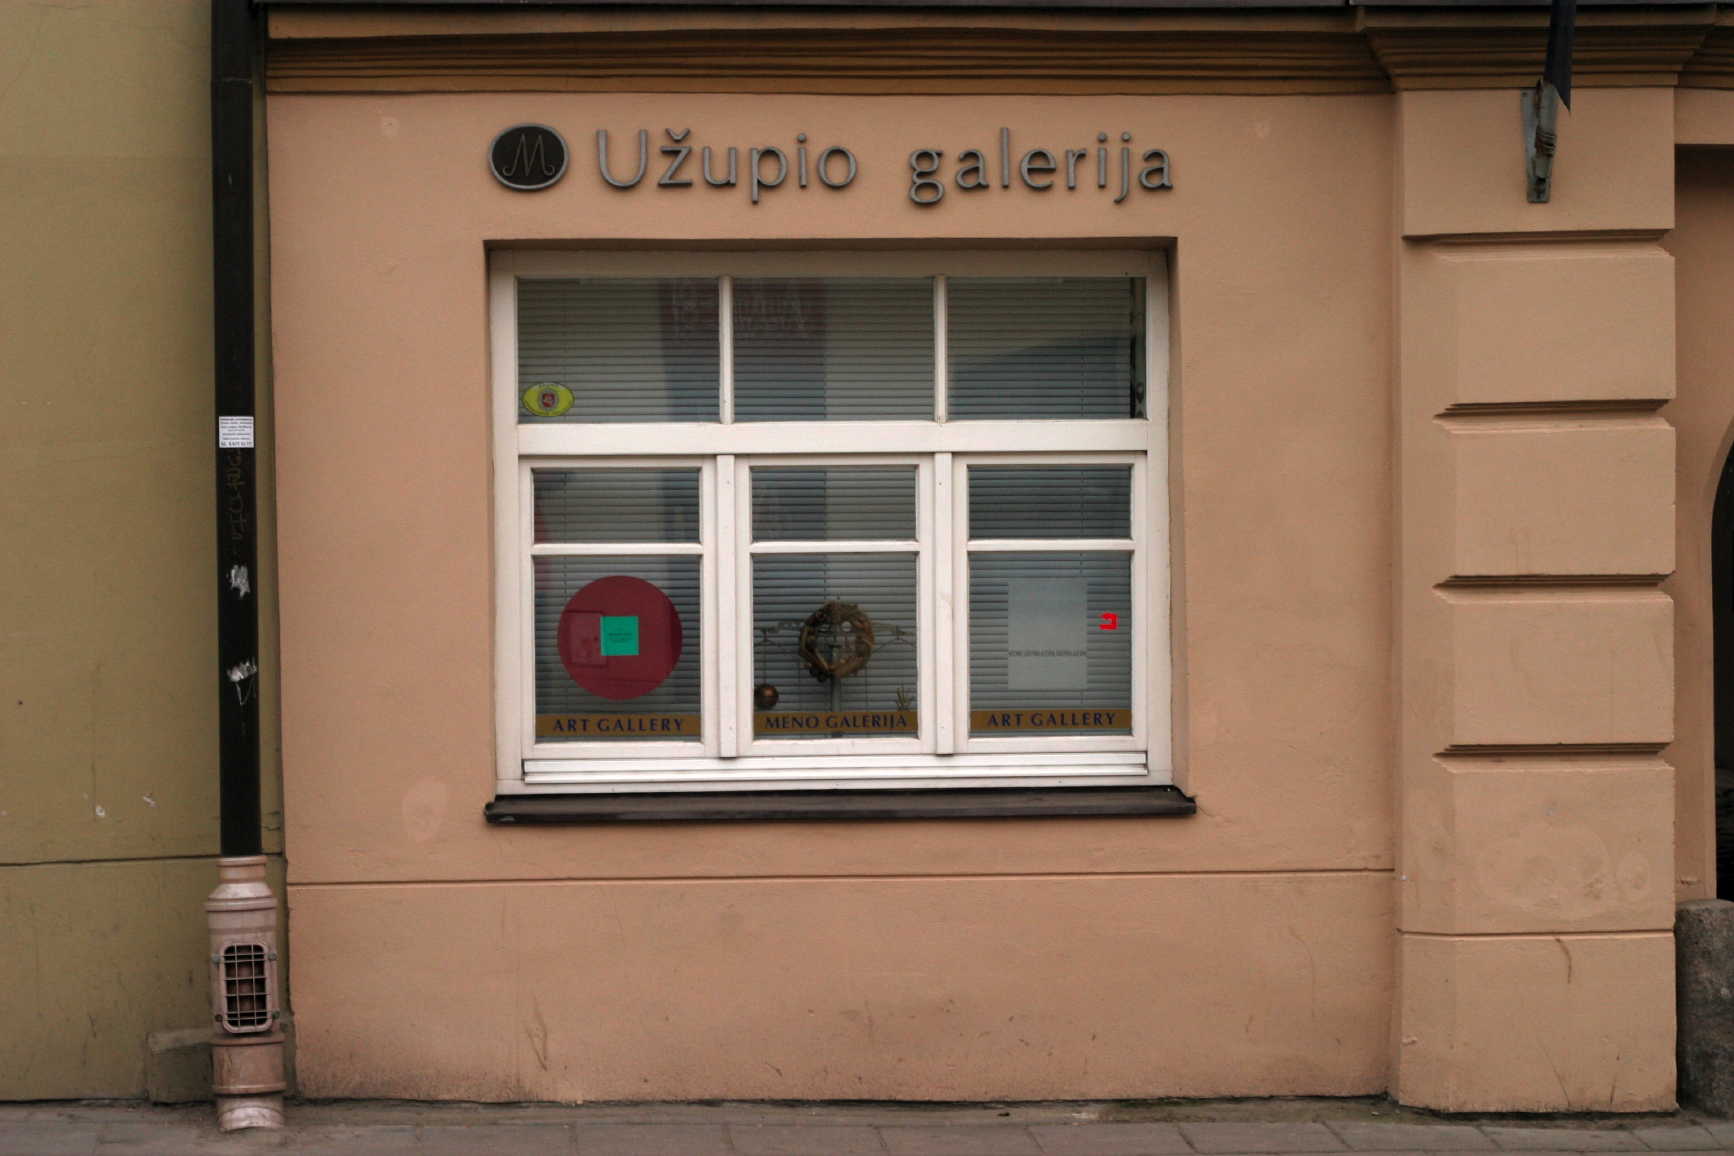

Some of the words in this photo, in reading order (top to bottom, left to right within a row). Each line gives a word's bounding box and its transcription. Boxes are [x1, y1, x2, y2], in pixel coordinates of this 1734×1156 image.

[595, 126, 860, 205] Užupio
[908, 127, 1174, 206] galerija
[553, 718, 591, 732] ART
[597, 717, 684, 732] GALLERY
[765, 715, 819, 729] MENO
[826, 714, 908, 729] GALERIJA
[988, 713, 1025, 727] ART
[1030, 712, 1118, 727] GALLERY
